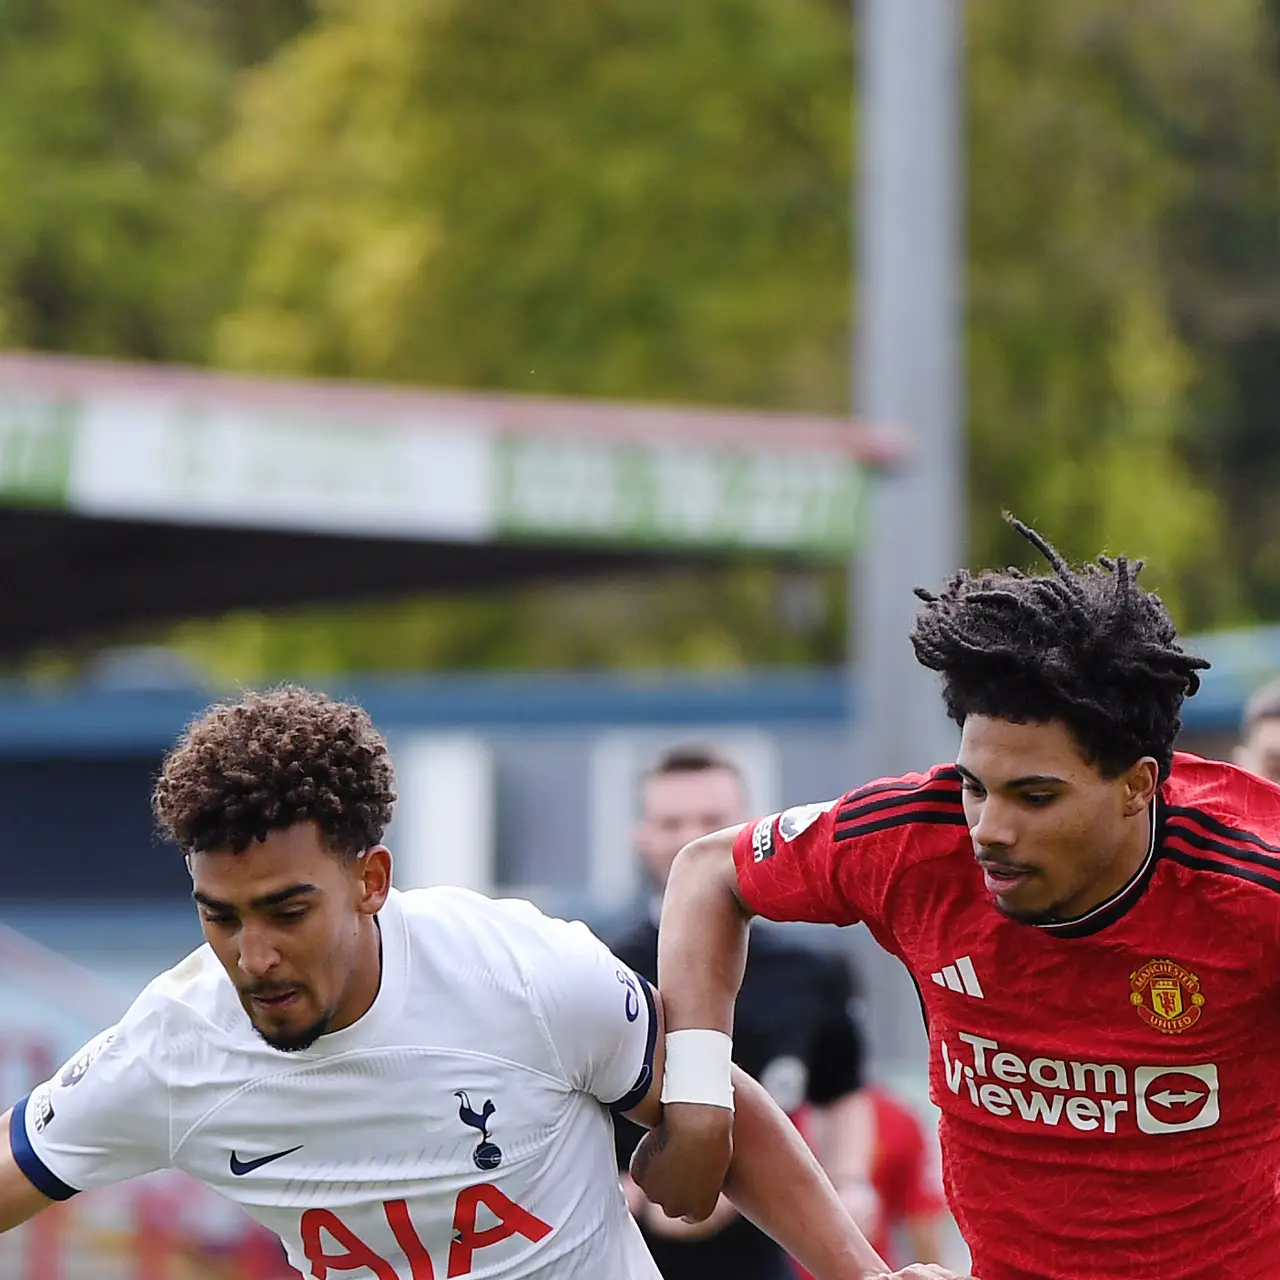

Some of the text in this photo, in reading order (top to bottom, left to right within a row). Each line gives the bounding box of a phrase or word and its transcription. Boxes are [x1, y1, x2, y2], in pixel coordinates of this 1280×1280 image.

[1134, 964, 1195, 989] MANCHESTER
[1150, 1015, 1192, 1029] UNITED
[959, 1031, 1128, 1095] Team
[941, 1040, 1128, 1134] Viewer
